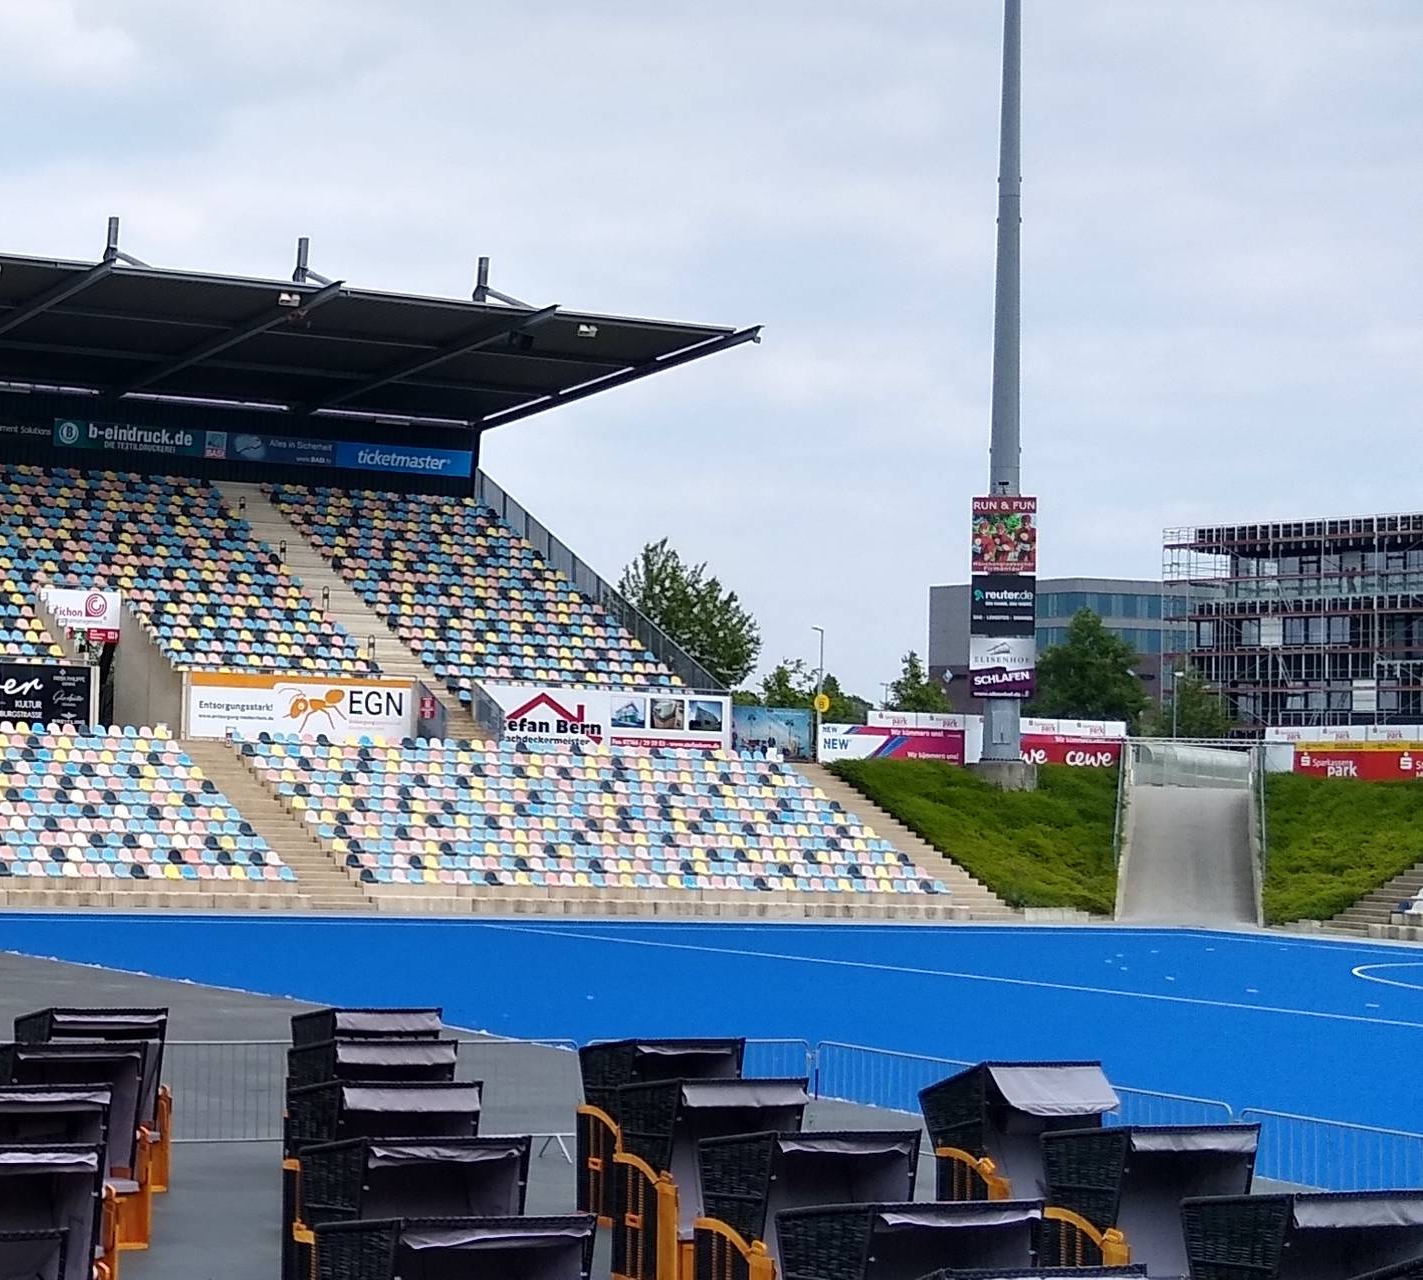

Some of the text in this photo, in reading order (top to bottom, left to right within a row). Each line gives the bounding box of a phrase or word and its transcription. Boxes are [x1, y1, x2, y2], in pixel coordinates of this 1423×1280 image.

[20, 426, 52, 436] Solutions
[88, 423, 193, 447] b-eindruck.de
[269, 439, 332, 452] Alles in Sicherheit
[973, 501, 1035, 510] RUN & FUN
[985, 590, 1033, 600] reuter.de
[974, 671, 1030, 686] SCHLAFEN
[15, 699, 42, 709] KULTUR
[198, 700, 274, 712] Entsorgungsstark!
[349, 690, 403, 717] EGN
[504, 718, 602, 735] efan Bern
[505, 734, 590, 745] achdeckermeister
[823, 738, 849, 750] NEW
[1019, 748, 1114, 767] we cewe
[1327, 761, 1358, 777] park
